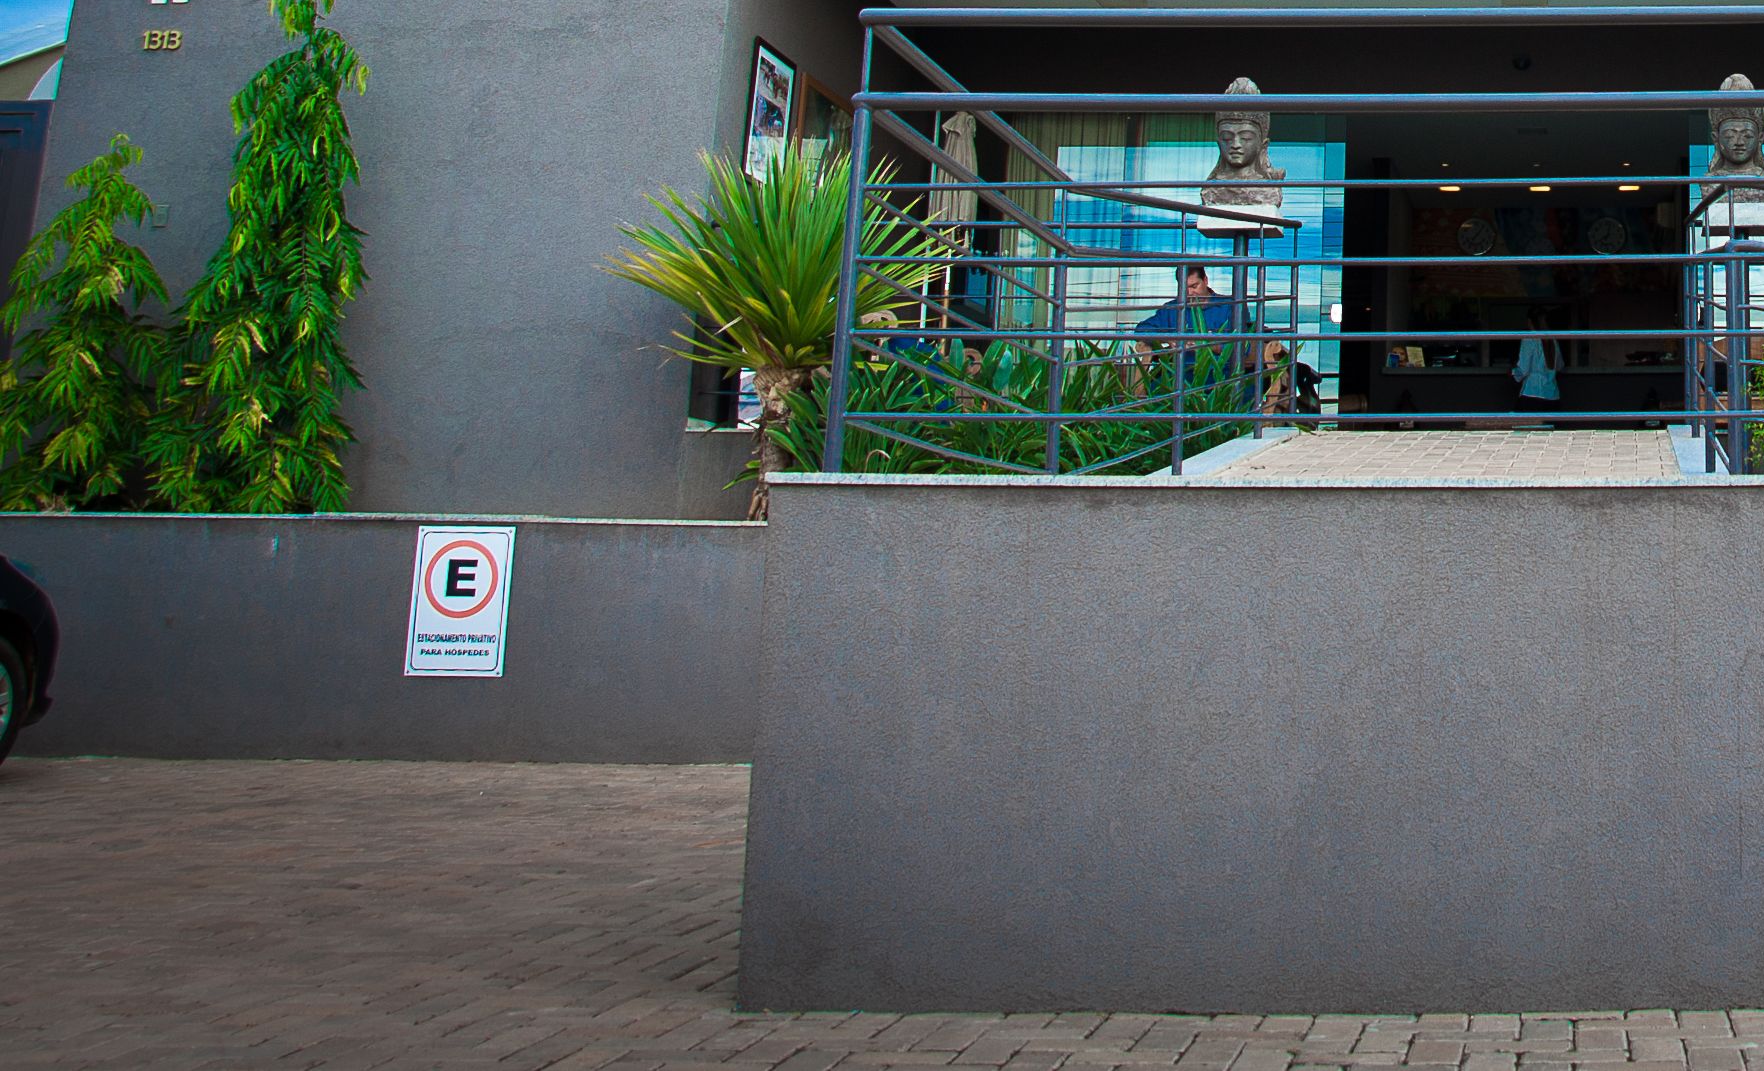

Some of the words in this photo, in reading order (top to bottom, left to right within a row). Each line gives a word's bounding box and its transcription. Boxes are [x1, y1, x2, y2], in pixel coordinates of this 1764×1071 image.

[143, 30, 182, 50] 1313
[445, 558, 478, 597] E
[420, 648, 443, 656] PARA
